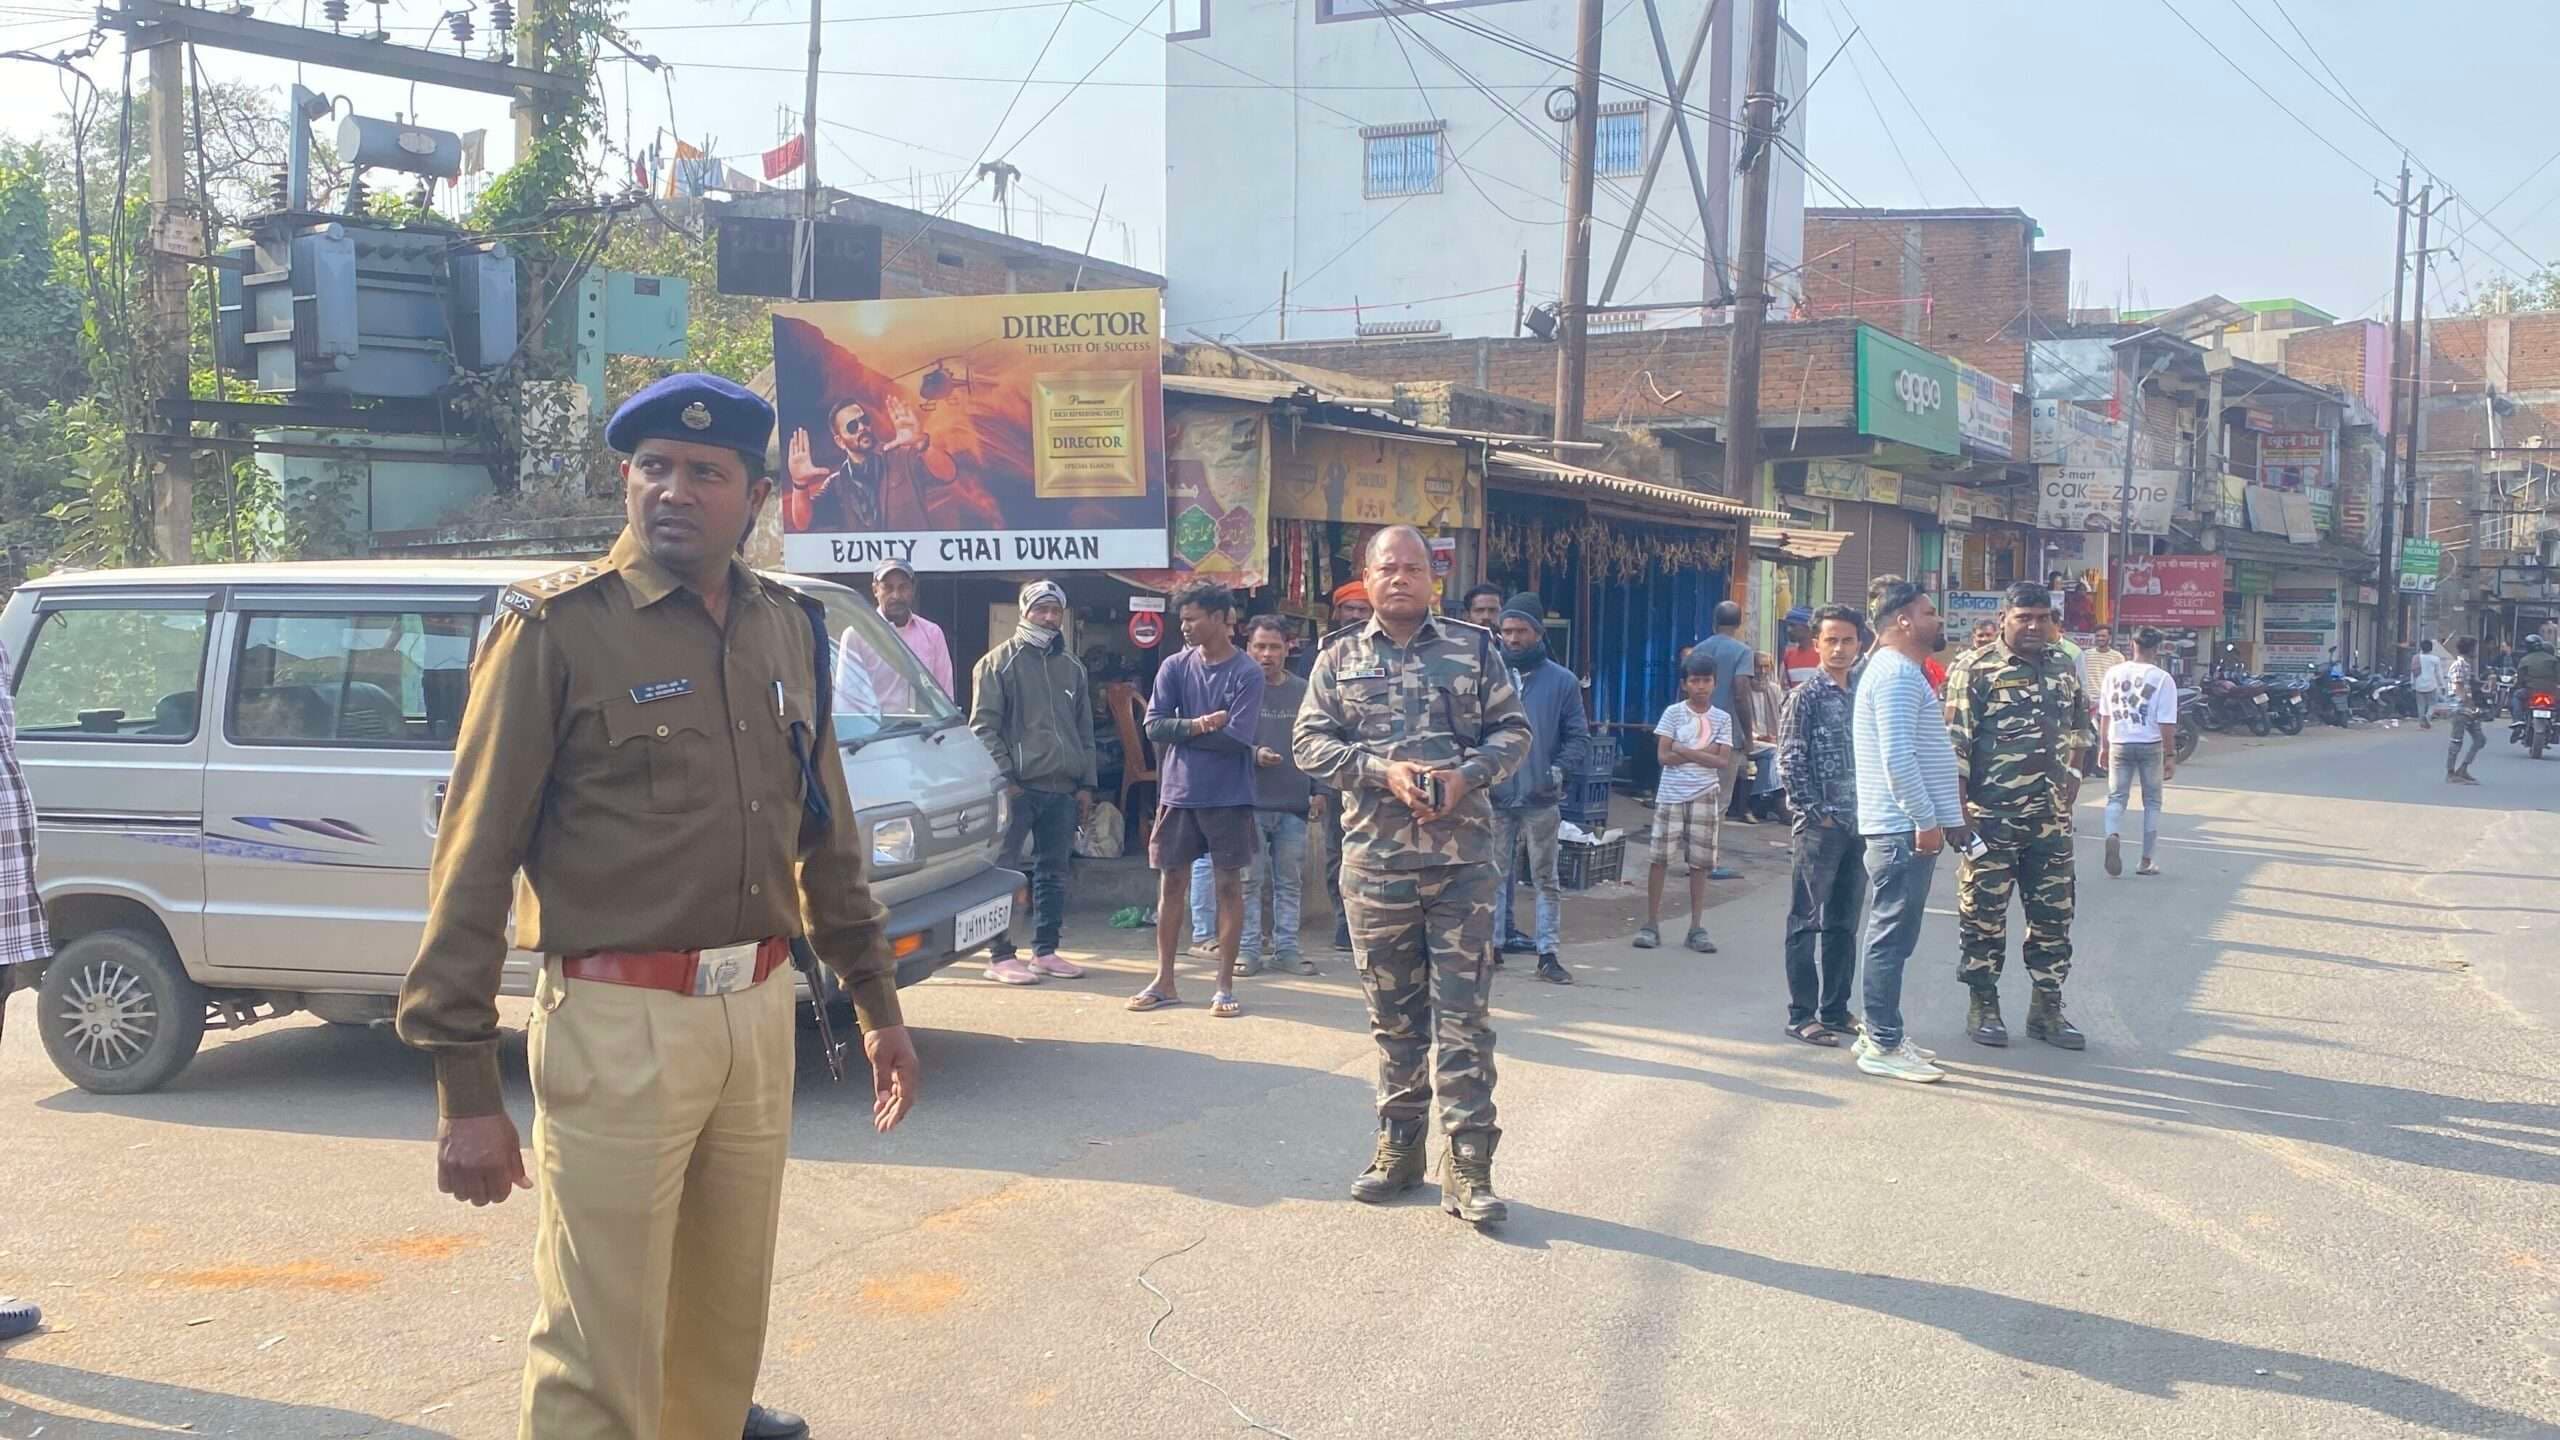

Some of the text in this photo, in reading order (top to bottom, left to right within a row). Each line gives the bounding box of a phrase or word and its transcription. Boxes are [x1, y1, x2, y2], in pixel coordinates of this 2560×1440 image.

[1002, 311, 1149, 340] DIRECTOR
[1026, 343, 1048, 355] THE
[1053, 342, 1083, 354] TASTE
[1105, 340, 1151, 353] SUCCESS
[1052, 435, 1122, 449] DIRECTOR
[831, 535, 1099, 563] BUNTY CHAI DUKAN
[2173, 598, 2204, 608] SELECT
